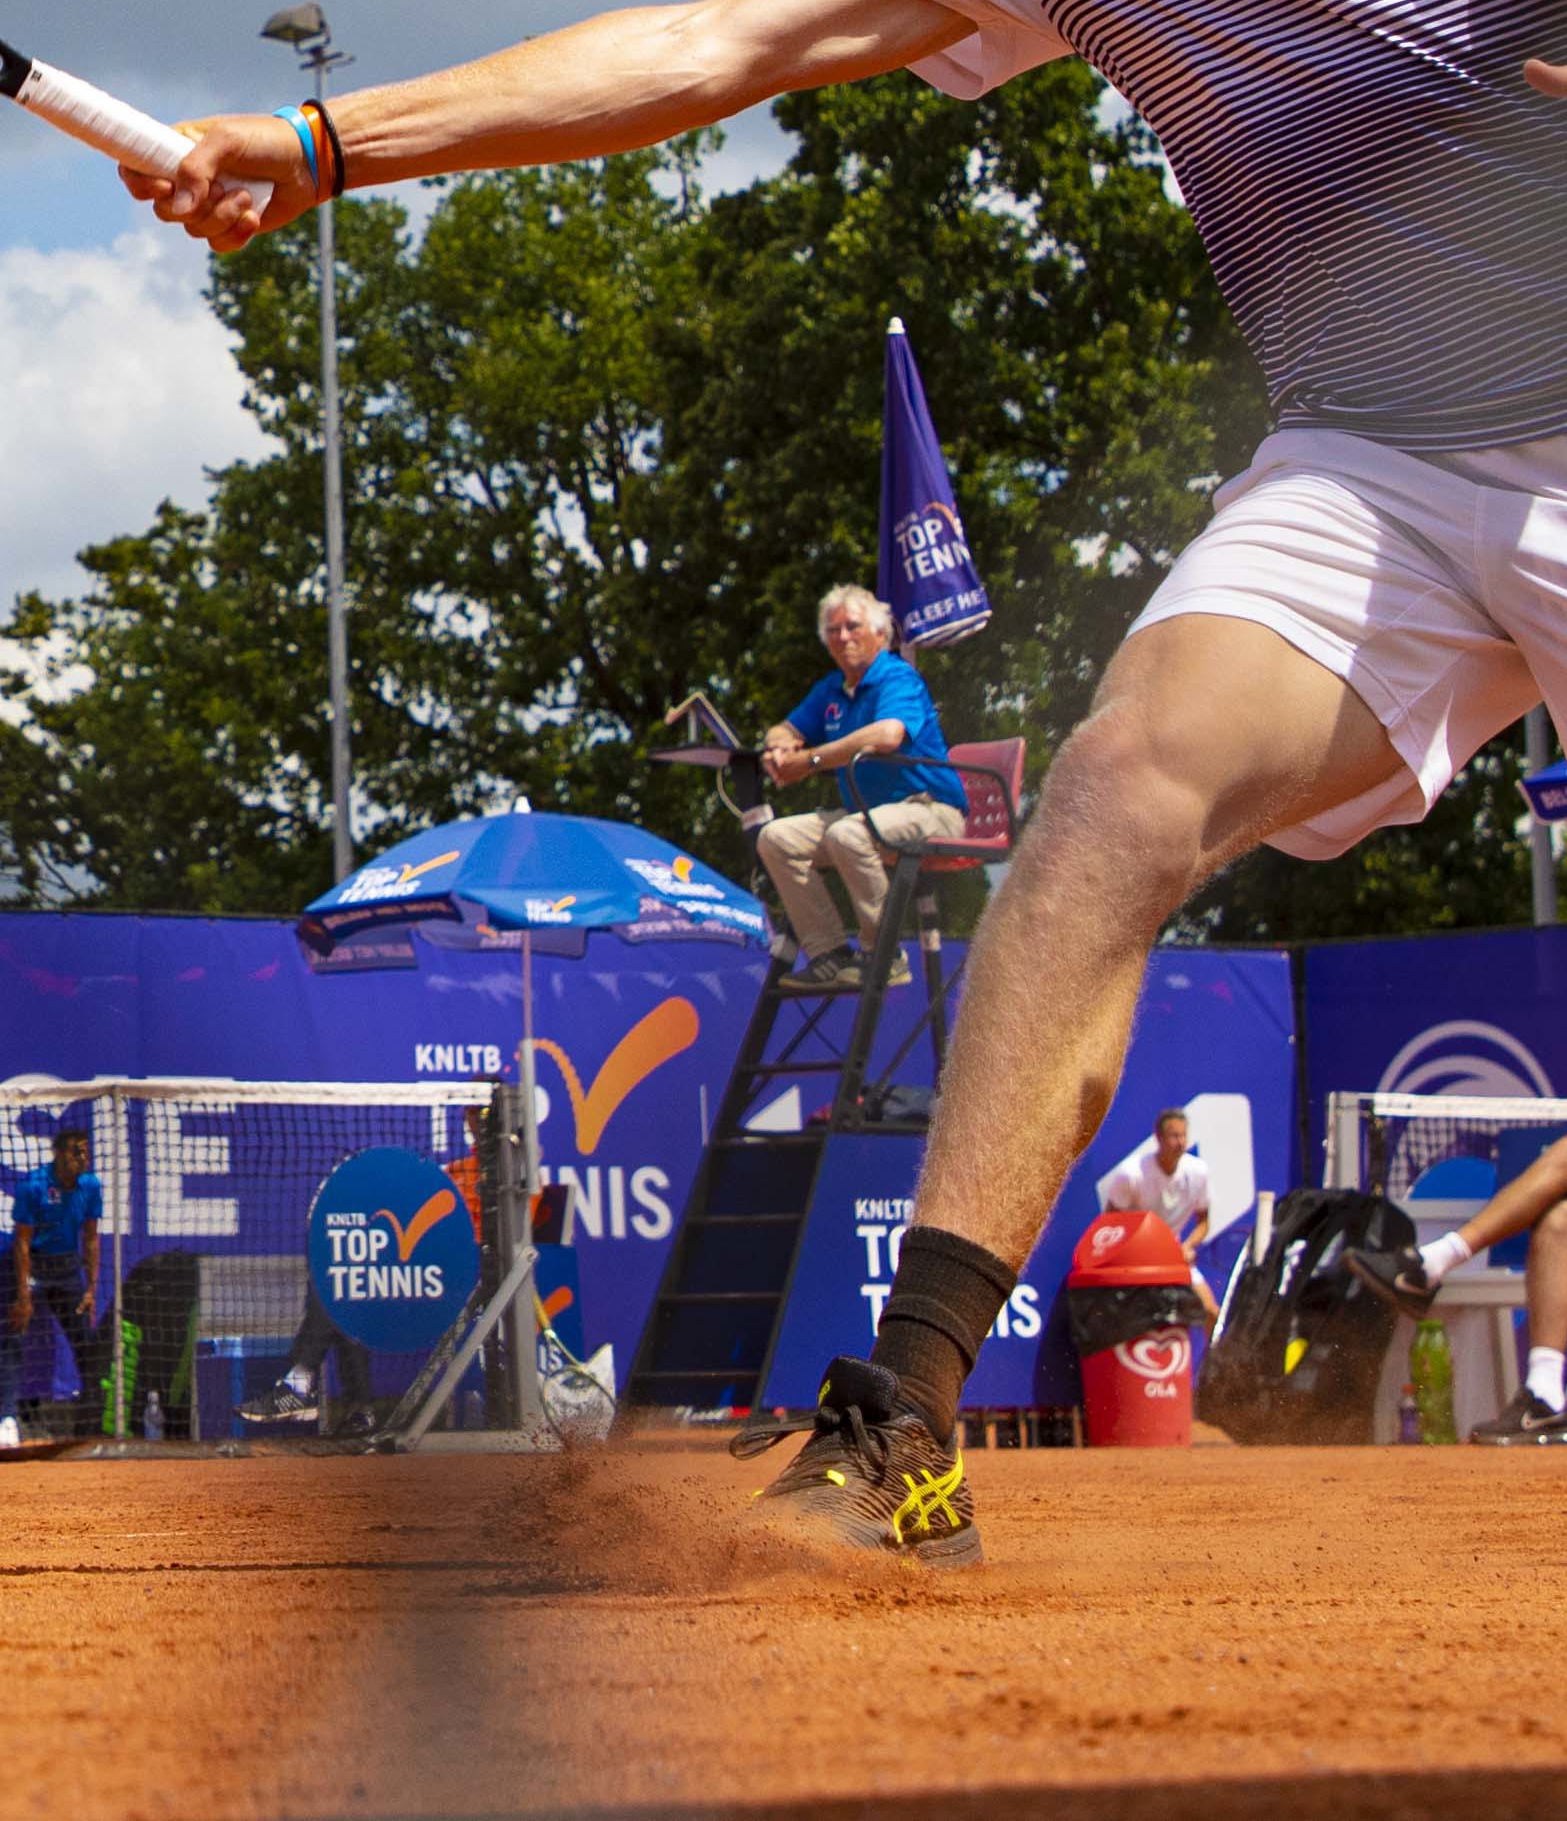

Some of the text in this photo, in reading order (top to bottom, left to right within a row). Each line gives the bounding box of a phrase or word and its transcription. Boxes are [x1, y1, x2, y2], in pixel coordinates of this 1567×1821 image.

[896, 518, 944, 558] TOP
[904, 540, 972, 584] TENN
[415, 1044, 502, 1073] KNLTB
[326, 1212, 367, 1227] KNLTB
[327, 1229, 389, 1262] TOP
[328, 1264, 444, 1301] TENNIS
